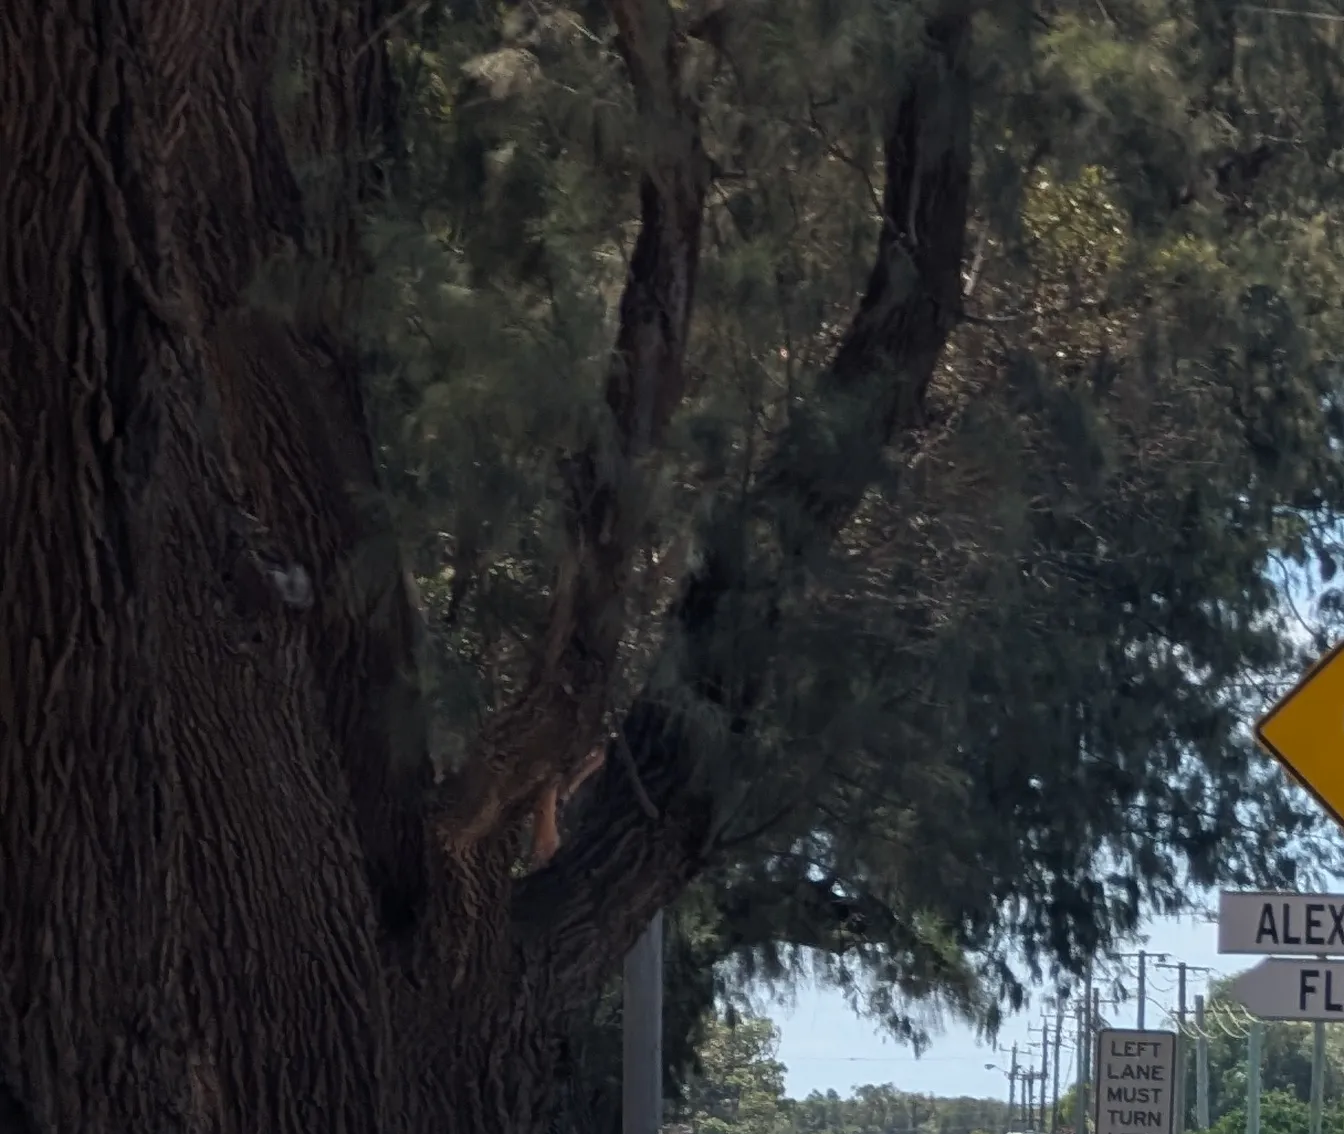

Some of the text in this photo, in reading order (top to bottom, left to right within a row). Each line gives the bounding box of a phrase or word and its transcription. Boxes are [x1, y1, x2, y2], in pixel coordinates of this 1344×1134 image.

[1111, 1040, 1162, 1058] LEFT
[1107, 1063, 1165, 1081] LANE
[1107, 1086, 1163, 1104] MUST
[1107, 1109, 1162, 1127] TURN
